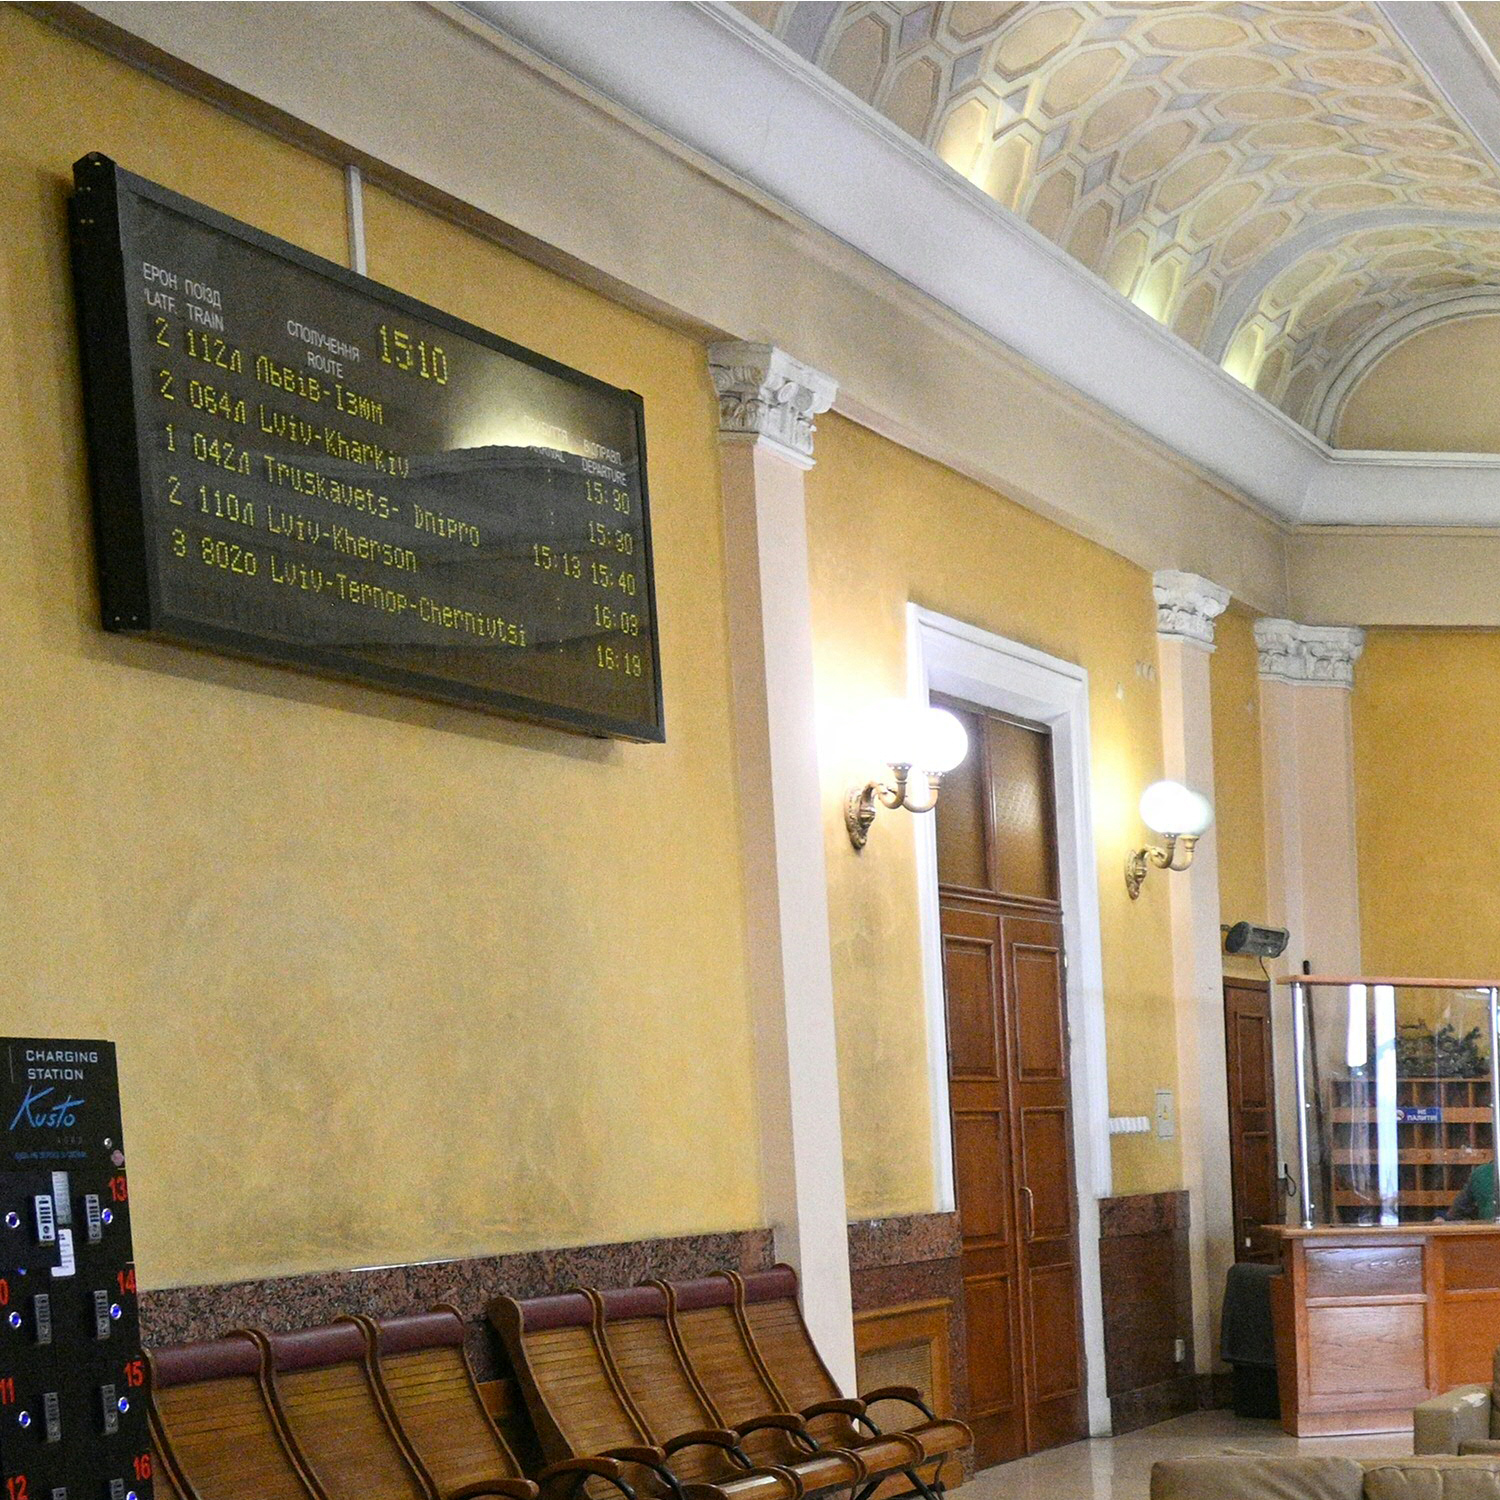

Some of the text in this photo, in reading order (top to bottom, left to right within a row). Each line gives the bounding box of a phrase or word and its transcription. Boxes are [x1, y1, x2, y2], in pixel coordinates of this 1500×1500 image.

[184, 279, 222, 310] ПОЇЗД
[144, 288, 225, 332] LATF. TRAIN
[155, 317, 170, 347] 2
[286, 320, 361, 363] СПОЛУЧЕННЯ
[307, 351, 344, 379] ROUTE
[159, 370, 175, 400] 2
[259, 404, 409, 479] Lviv-Kharkiv
[581, 457, 628, 487] DEPARTURE
[165, 423, 176, 452] 1
[413, 503, 480, 548] Dnipro
[591, 562, 636, 596] 15:40
[167, 475, 183, 506] 2
[267, 505, 417, 573] Lviv-Kherson
[172, 528, 187, 557] 3
[26, 1050, 98, 1063] CHARGING
[27, 1068, 84, 1080] STATION
[9, 1084, 85, 1130] Kusto
[108, 1175, 128, 1202] 13
[117, 1269, 137, 1296] 14
[124, 1361, 144, 1387] 15
[133, 1454, 152, 1480] 16
